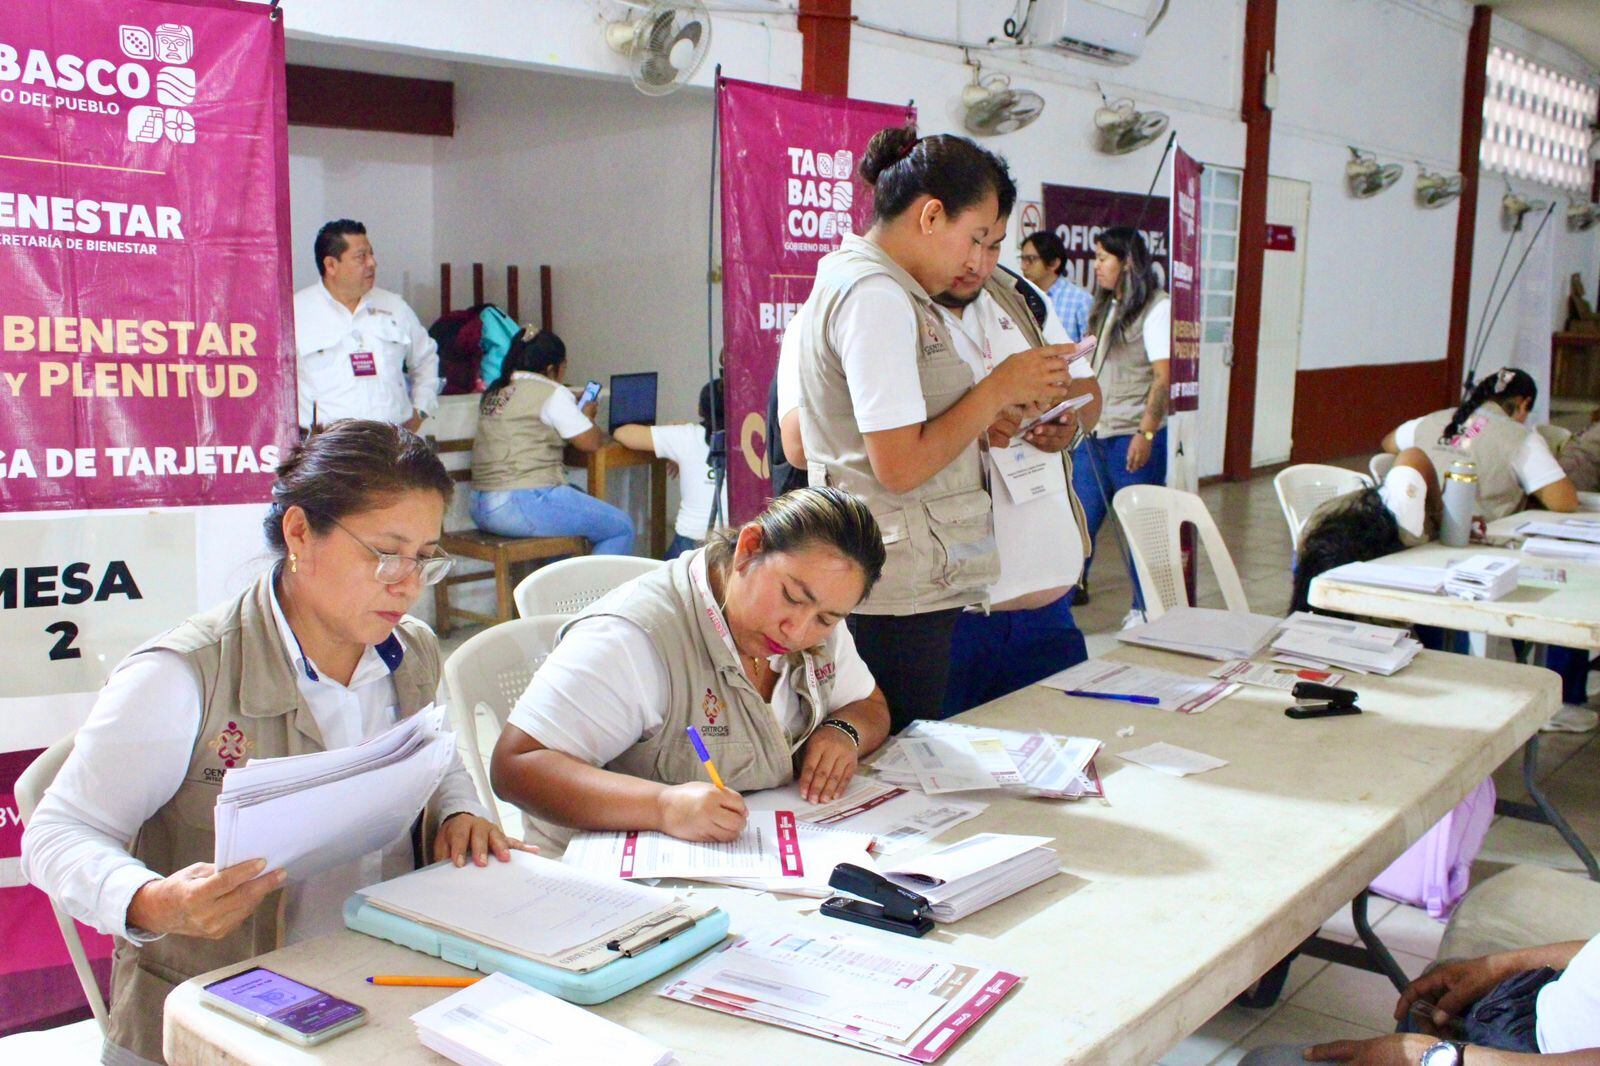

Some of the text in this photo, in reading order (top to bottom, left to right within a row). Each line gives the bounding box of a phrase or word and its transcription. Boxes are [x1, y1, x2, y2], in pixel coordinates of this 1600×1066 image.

[19, 90, 51, 108] DEL
[57, 97, 120, 116] PUEBLO
[788, 178, 832, 209] BAS
[66, 237, 83, 250] DE
[86, 241, 157, 256] BIENESTAR
[784, 241, 818, 253] GOBIERNO
[3, 315, 258, 356] BIENESTAR
[4, 362, 258, 398] Y PLENITUD
[46, 448, 96, 478] DE
[105, 445, 280, 477] TARJETAS
[44, 620, 82, 661] 2
